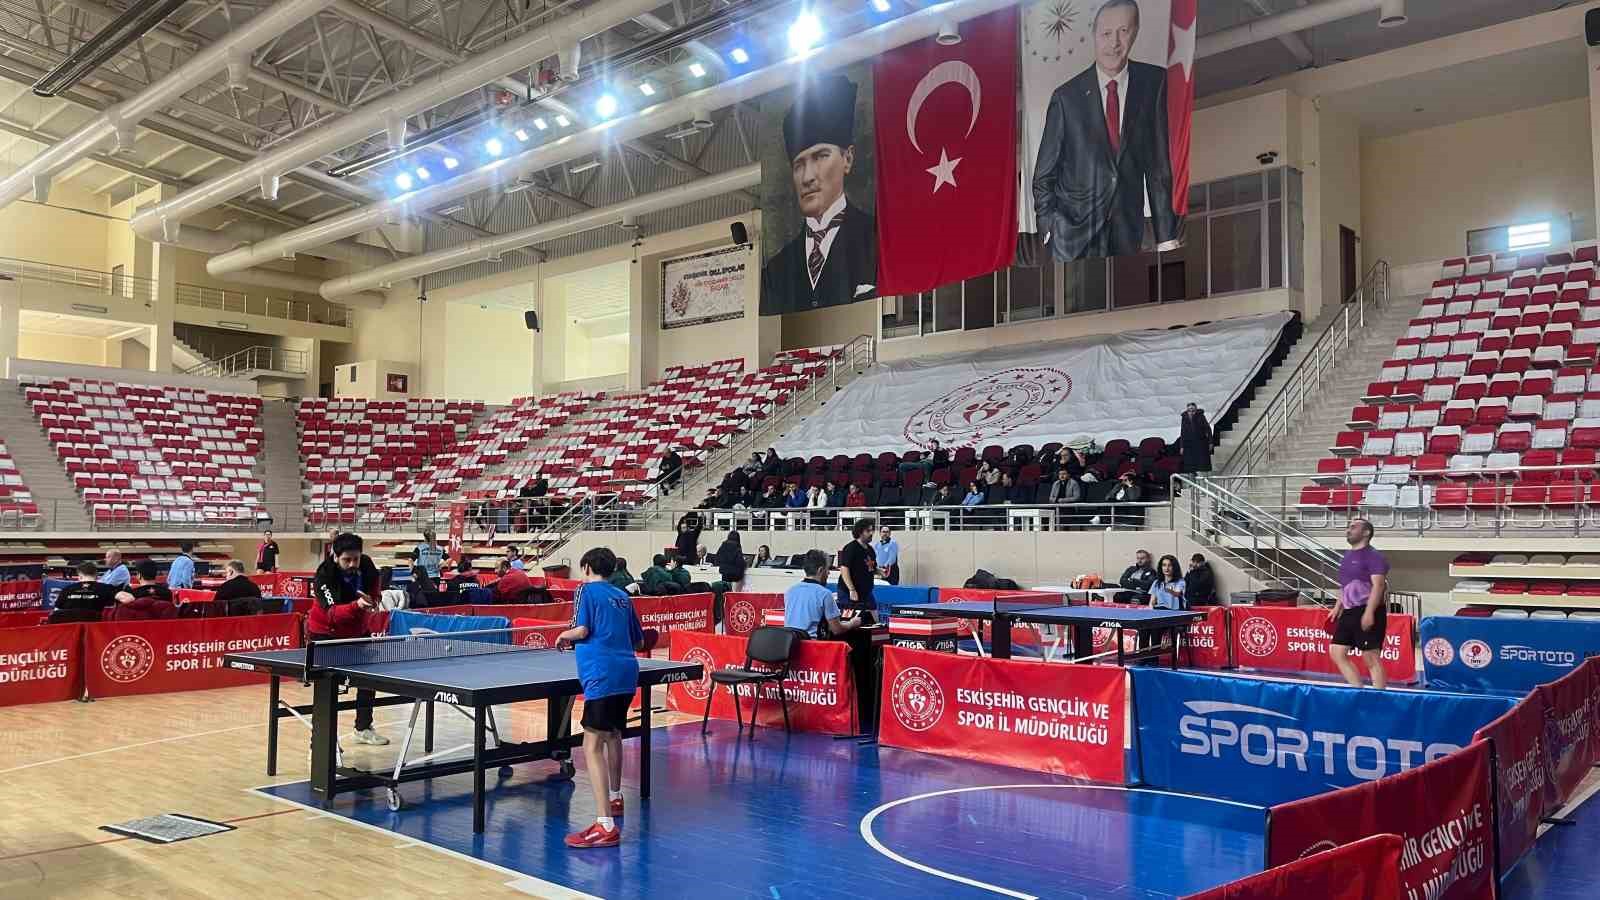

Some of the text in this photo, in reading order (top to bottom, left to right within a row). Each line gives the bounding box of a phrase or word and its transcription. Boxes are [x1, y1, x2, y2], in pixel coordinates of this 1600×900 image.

[641, 611, 673, 623] ESKİŞEHİR
[1202, 625, 1215, 635] VE
[166, 635, 290, 656] ESKİŞEHİR GENÇLİK VE
[896, 641, 926, 650] STIGA
[1287, 641, 1326, 654] SPOR İL
[1386, 635, 1401, 646] VE
[0, 649, 69, 667] ENÇLİK VE
[1500, 649, 1575, 663] SPORTOTO
[166, 659, 199, 672] SPOR
[202, 655, 214, 669] İL
[0, 663, 67, 683] DÜRLÜĞÜ
[661, 671, 689, 683] STIGA
[821, 672, 837, 685] VE
[434, 691, 459, 705] STIGA
[956, 687, 1110, 720] ESKİŞEHİR GENÇLİK VE
[957, 711, 1109, 746] SPOR İL MÜDÜRLÜĞÜ
